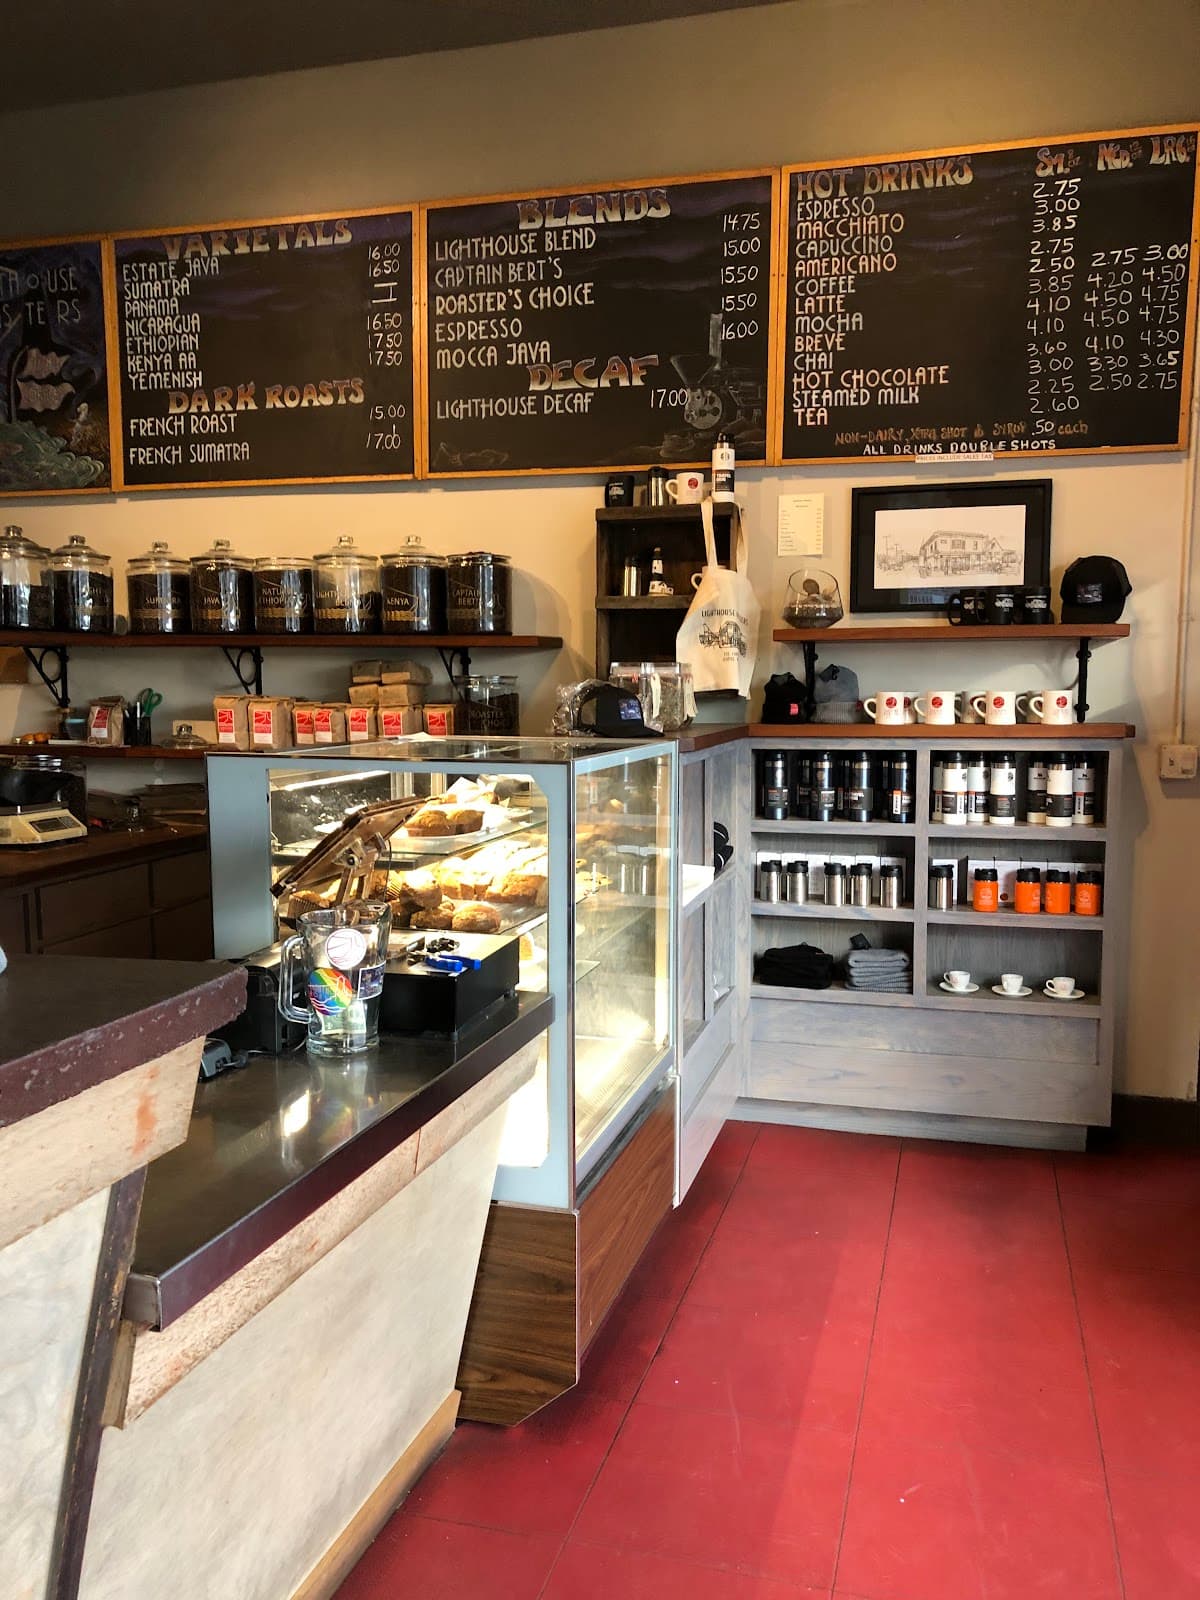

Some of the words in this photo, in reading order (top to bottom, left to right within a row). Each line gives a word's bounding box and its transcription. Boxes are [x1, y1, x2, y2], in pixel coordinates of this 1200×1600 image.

[798, 168, 853, 200] HOT
[864, 156, 973, 195] DRINKS
[1033, 178, 1081, 198] 2.75
[517, 189, 671, 230] BLENDS
[797, 197, 874, 221] ESPRESSO
[1035, 198, 1080, 215] 3.00
[723, 213, 760, 232] 14.75
[797, 213, 904, 239] MACCHIATO
[1032, 215, 1078, 232] 3.85
[160, 219, 353, 260] VARIETALS
[435, 232, 537, 261] LIGHTHOUSE
[544, 228, 596, 252] BLEND
[724, 237, 760, 256] 15.00
[796, 235, 892, 258] CAPUCCINO
[1030, 238, 1074, 254] 2.75
[368, 243, 400, 260] 16.00
[1091, 248, 1138, 266] 2.75
[1142, 243, 1188, 261] 3.00
[123, 260, 177, 282] ESTATE
[185, 257, 219, 278] JAVA
[435, 263, 503, 288] CAPTAIN
[509, 256, 563, 283] BERT'S
[795, 253, 897, 277] AMERICANO
[124, 278, 190, 300] SUMATRA
[795, 276, 856, 296] COFFEE
[1029, 275, 1074, 294] 3.85
[1088, 271, 1133, 288] 4.20
[1142, 264, 1185, 283] 4.50
[125, 298, 179, 318] PANAMA
[436, 289, 522, 315] ROASTER'S
[529, 282, 594, 310] CHOICE
[795, 295, 845, 314] LATTE
[1027, 296, 1070, 315] 4.10
[1084, 290, 1132, 307] 4.50
[1142, 283, 1180, 302] 4.75
[126, 313, 200, 337] NICARAGUA
[435, 318, 522, 342] ESPRESSO
[795, 313, 863, 333] MOCHA
[1027, 318, 1064, 336] 4.10
[1084, 309, 1129, 327] 4.50
[1139, 303, 1179, 324] 4.75
[126, 334, 199, 355] ETHIOPIAN
[795, 333, 846, 352] BREVE
[1027, 342, 1067, 356] 3.60
[1085, 335, 1124, 353] 4.10
[1140, 330, 1179, 347] 4.30
[127, 353, 173, 373] KENYA
[178, 352, 196, 369] AA
[436, 348, 497, 369] MOCCA
[507, 341, 550, 365] JAVA
[794, 352, 832, 372] CHAI
[1028, 357, 1073, 374] 3.00
[1087, 356, 1128, 371] 3.30
[1139, 351, 1180, 367] 3.65
[128, 371, 202, 390] YEMENISH
[527, 354, 659, 391] DECAF
[793, 371, 833, 392] HOT
[841, 366, 949, 390] CHOCOLATE
[1028, 376, 1074, 394] 2.25
[1089, 374, 1132, 390] 2.50
[1138, 371, 1177, 389] 2.75
[168, 381, 258, 414] DARK
[265, 377, 365, 409] ROASTS
[437, 395, 537, 420] LIGHTHOUSE
[544, 392, 594, 415] DECAF
[651, 388, 688, 408] 17.00
[793, 388, 870, 408] STEAMED
[878, 387, 919, 405] MILK
[1030, 396, 1079, 413] 2.60
[370, 404, 406, 420] 15.00
[793, 408, 828, 426] TEA
[130, 415, 184, 437] FRENCH
[191, 413, 237, 434] ROAST
[1032, 419, 1055, 435] .50
[1058, 420, 1088, 434] each
[130, 446, 182, 466] FRENCH
[190, 442, 249, 464] SUMATRA
[863, 444, 886, 455] ALL
[894, 443, 943, 454] DRINKS
[950, 440, 1006, 454] DOUBLE
[1011, 440, 1055, 450] SHOTS
